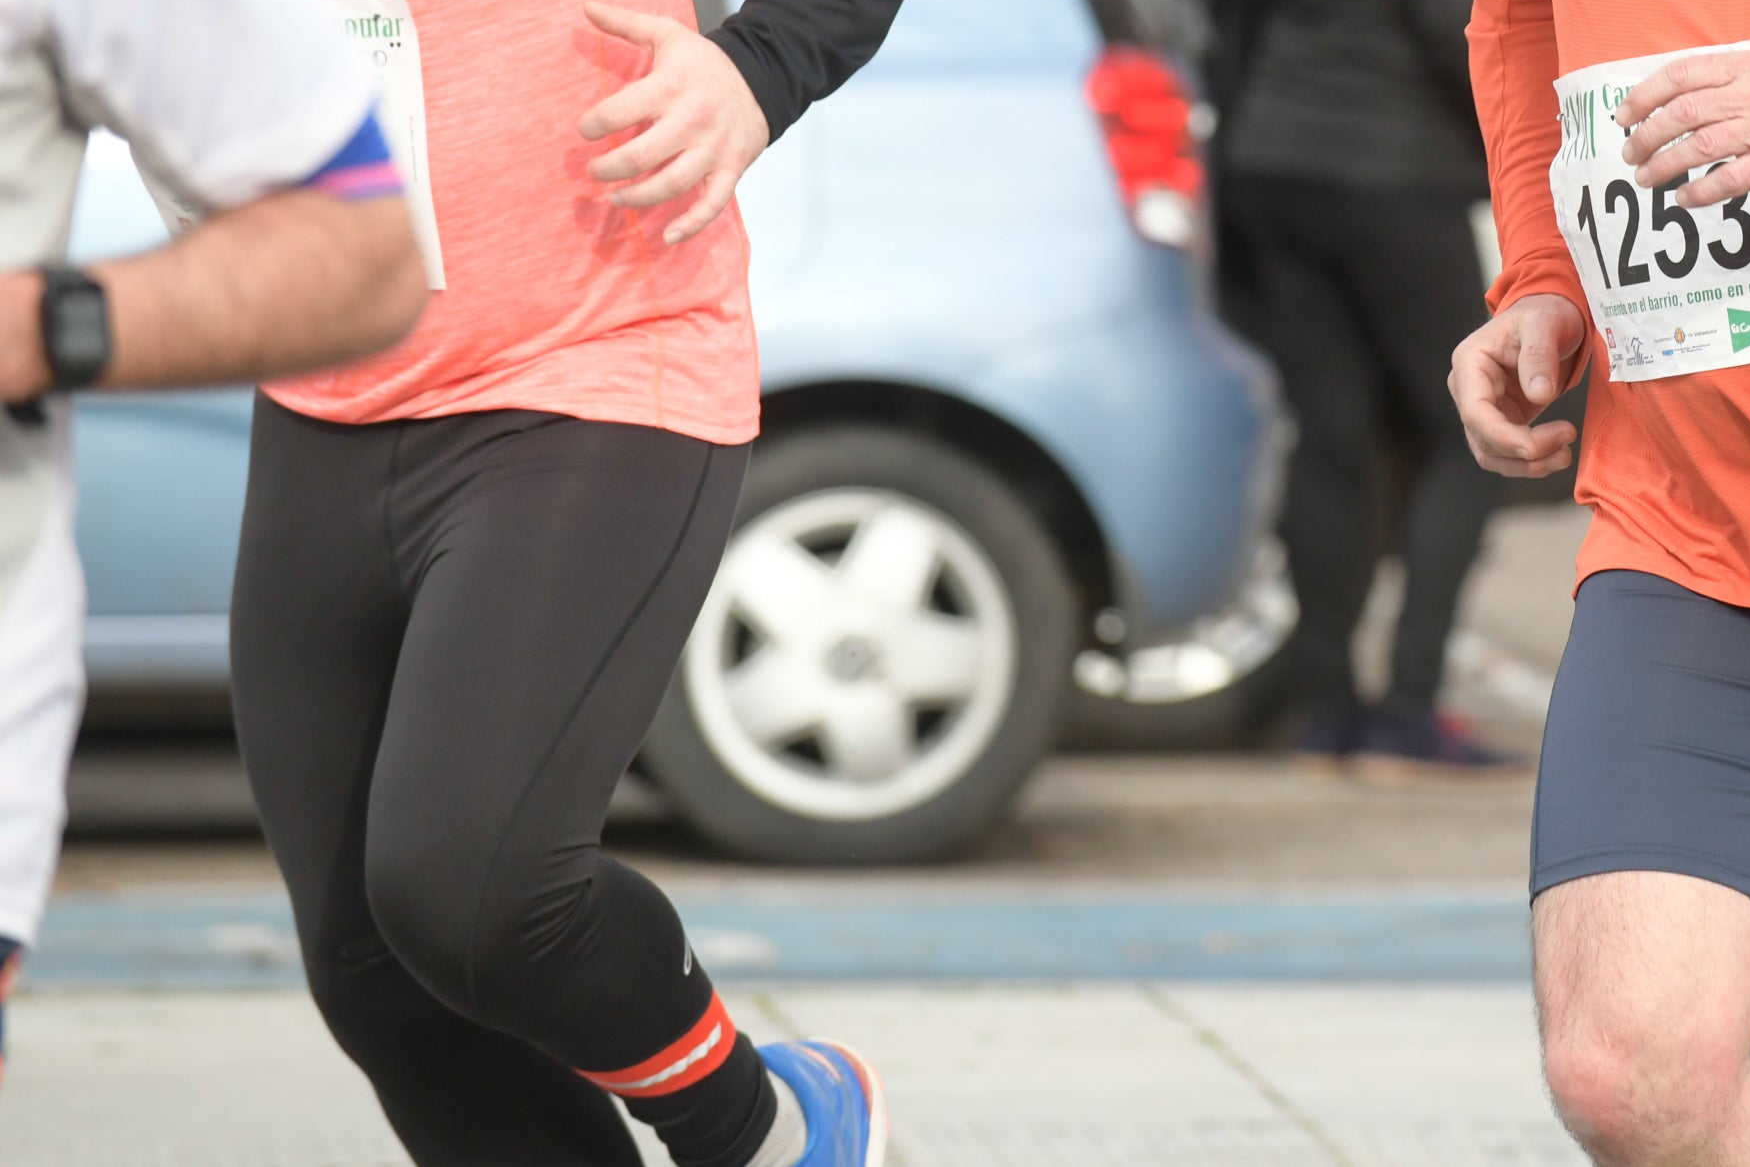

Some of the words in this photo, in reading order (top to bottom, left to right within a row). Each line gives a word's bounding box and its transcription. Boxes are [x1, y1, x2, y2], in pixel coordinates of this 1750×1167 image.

[1628, 301, 1639, 314] en
[1648, 292, 1683, 311] barrio,
[1686, 287, 1722, 304] como
[1727, 284, 1744, 298] en
